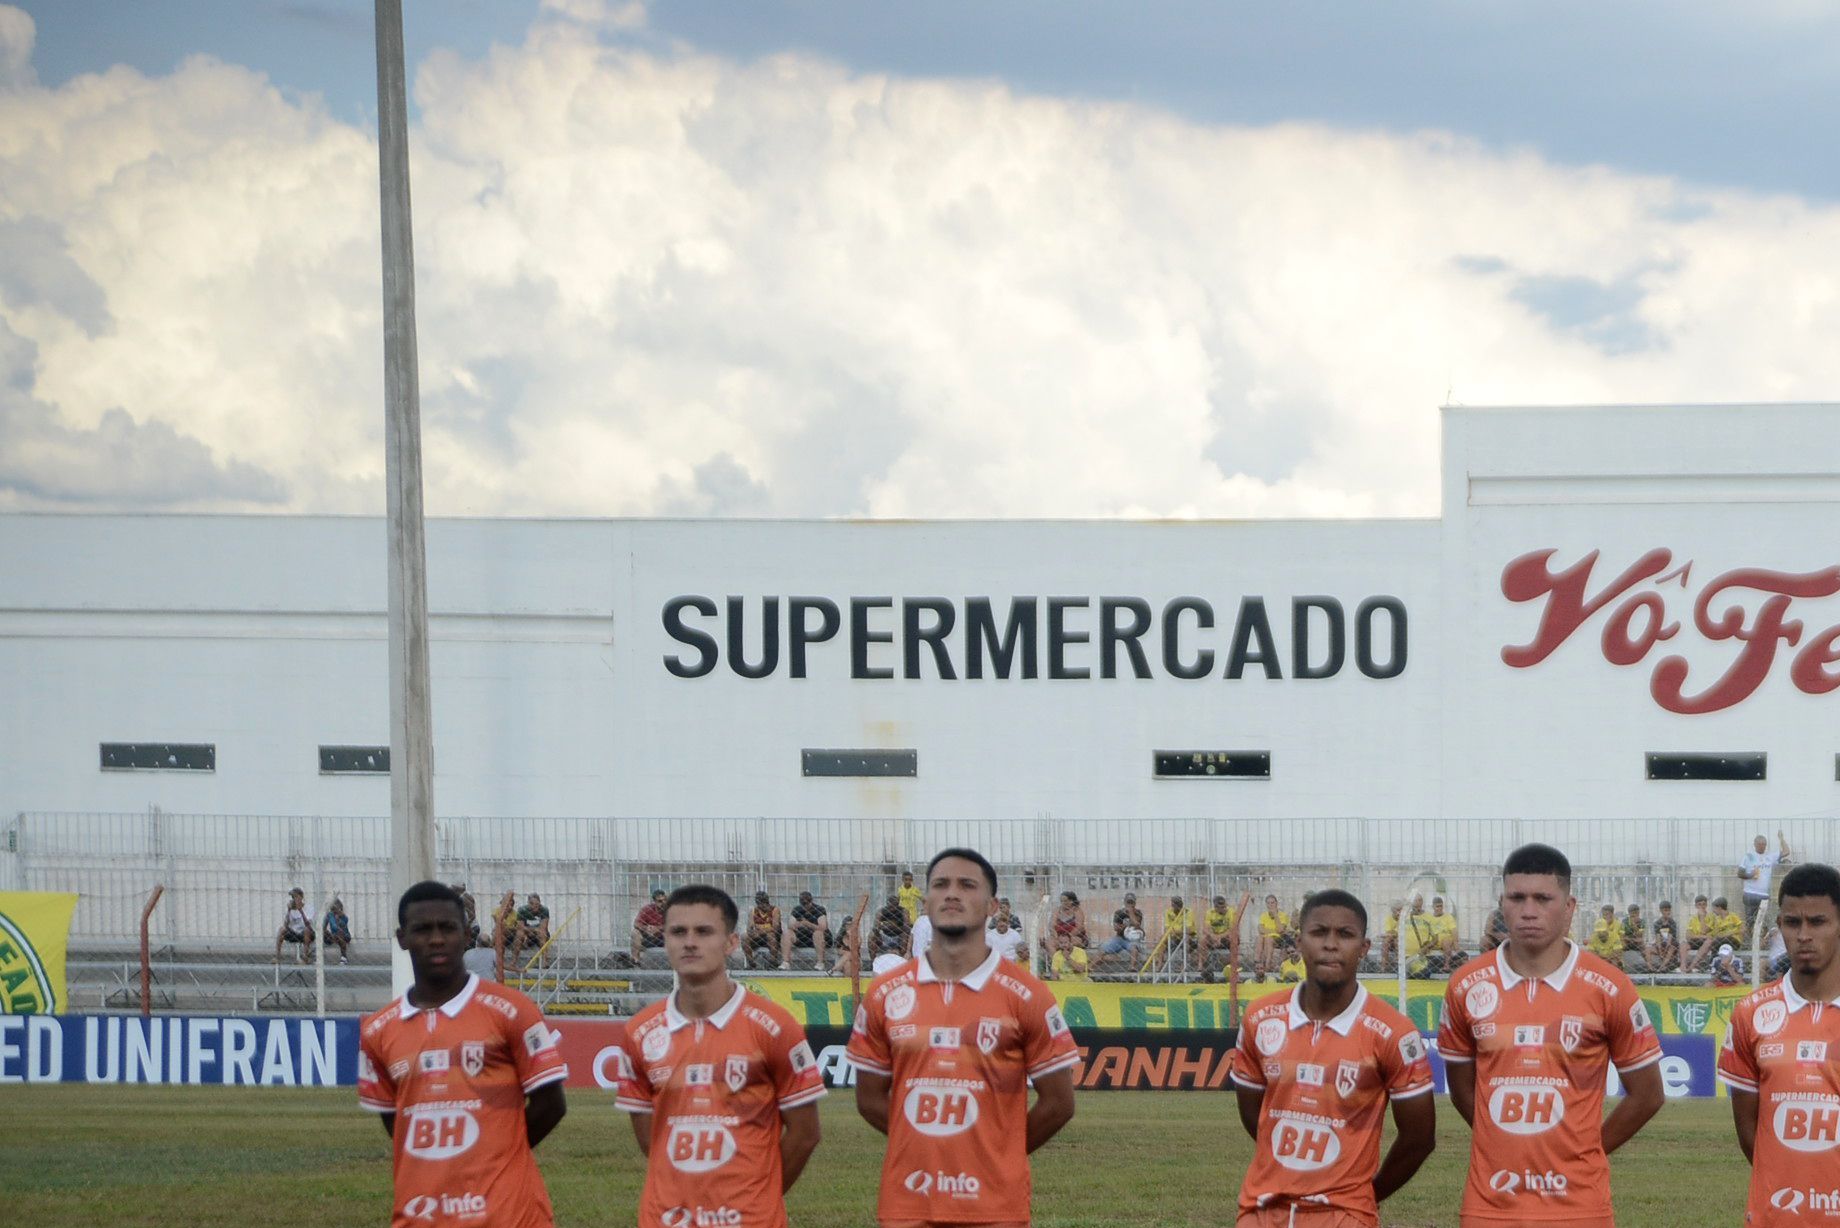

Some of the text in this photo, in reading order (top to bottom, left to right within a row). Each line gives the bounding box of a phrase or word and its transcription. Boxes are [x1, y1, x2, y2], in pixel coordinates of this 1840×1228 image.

[1500, 547, 1694, 668] Vô
[661, 595, 1409, 681] SUPERMERCADO
[86, 1017, 337, 1085] UNIFRAN
[916, 1092, 968, 1125] BH
[1500, 1092, 1556, 1124] BH
[1783, 1108, 1840, 1141] BH
[413, 1115, 466, 1149] BH
[674, 1130, 724, 1161] BH
[1277, 1126, 1331, 1163] BH
[937, 1169, 980, 1192] info
[1525, 1168, 1568, 1190] info
[440, 1192, 486, 1215] info
[697, 1206, 742, 1227] info
